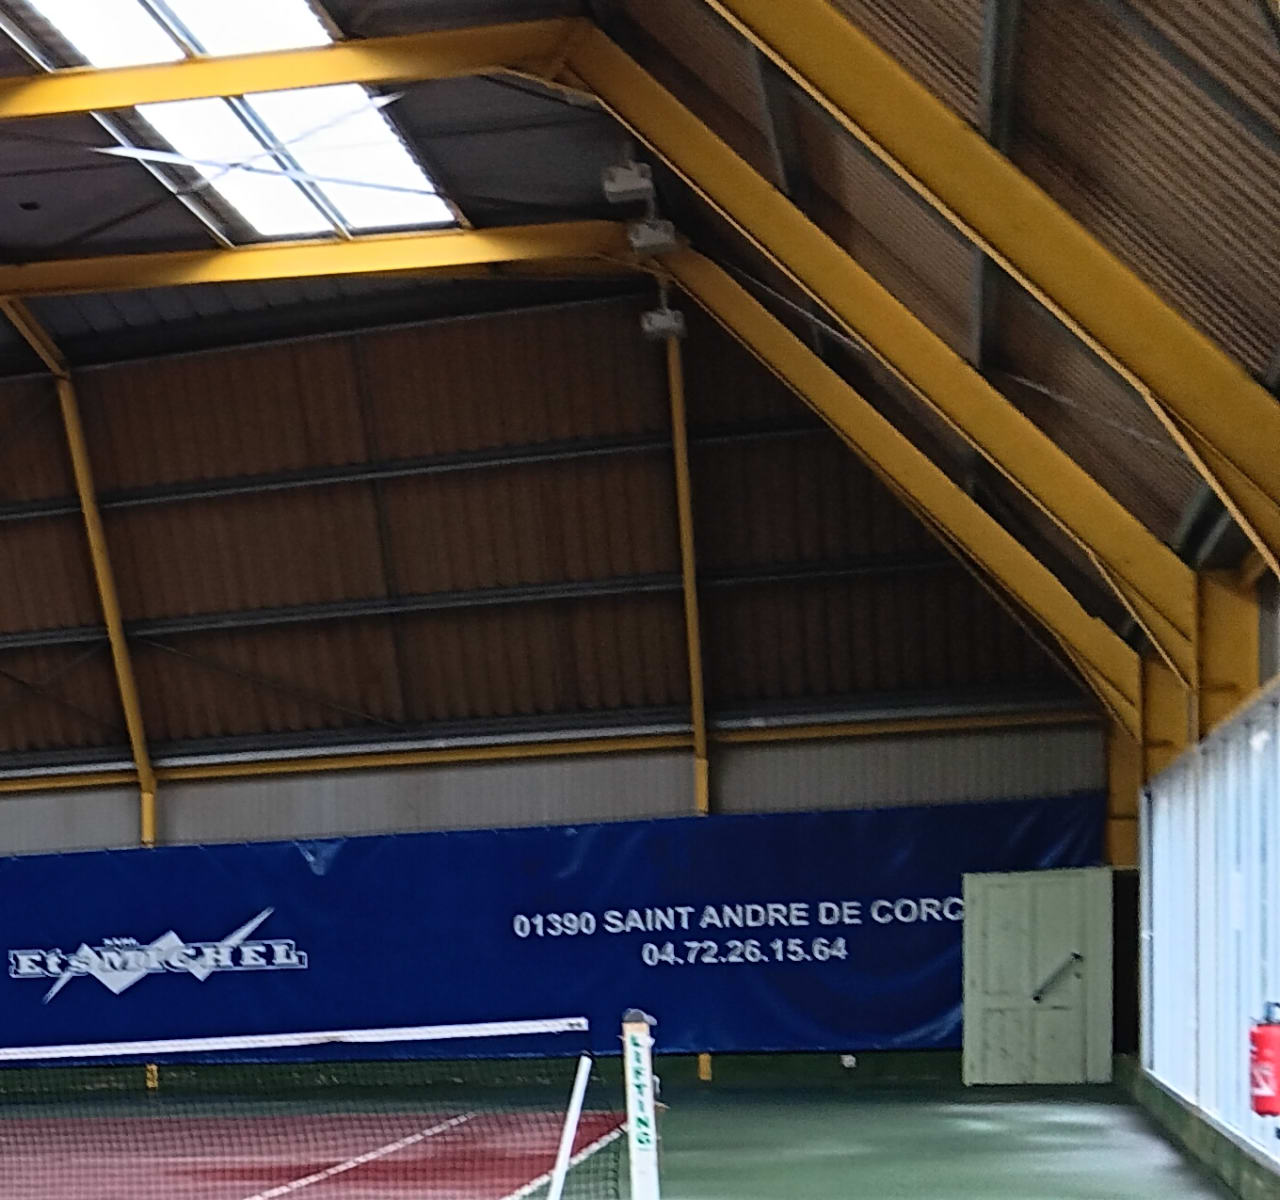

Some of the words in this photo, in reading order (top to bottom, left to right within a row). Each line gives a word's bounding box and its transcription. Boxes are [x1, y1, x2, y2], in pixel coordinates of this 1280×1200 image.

[513, 911, 597, 938] 01390
[603, 906, 695, 934] SAINT
[698, 902, 810, 929] ANDRE
[818, 901, 863, 926] DE
[641, 936, 849, 967] 04.72.26.15.64
